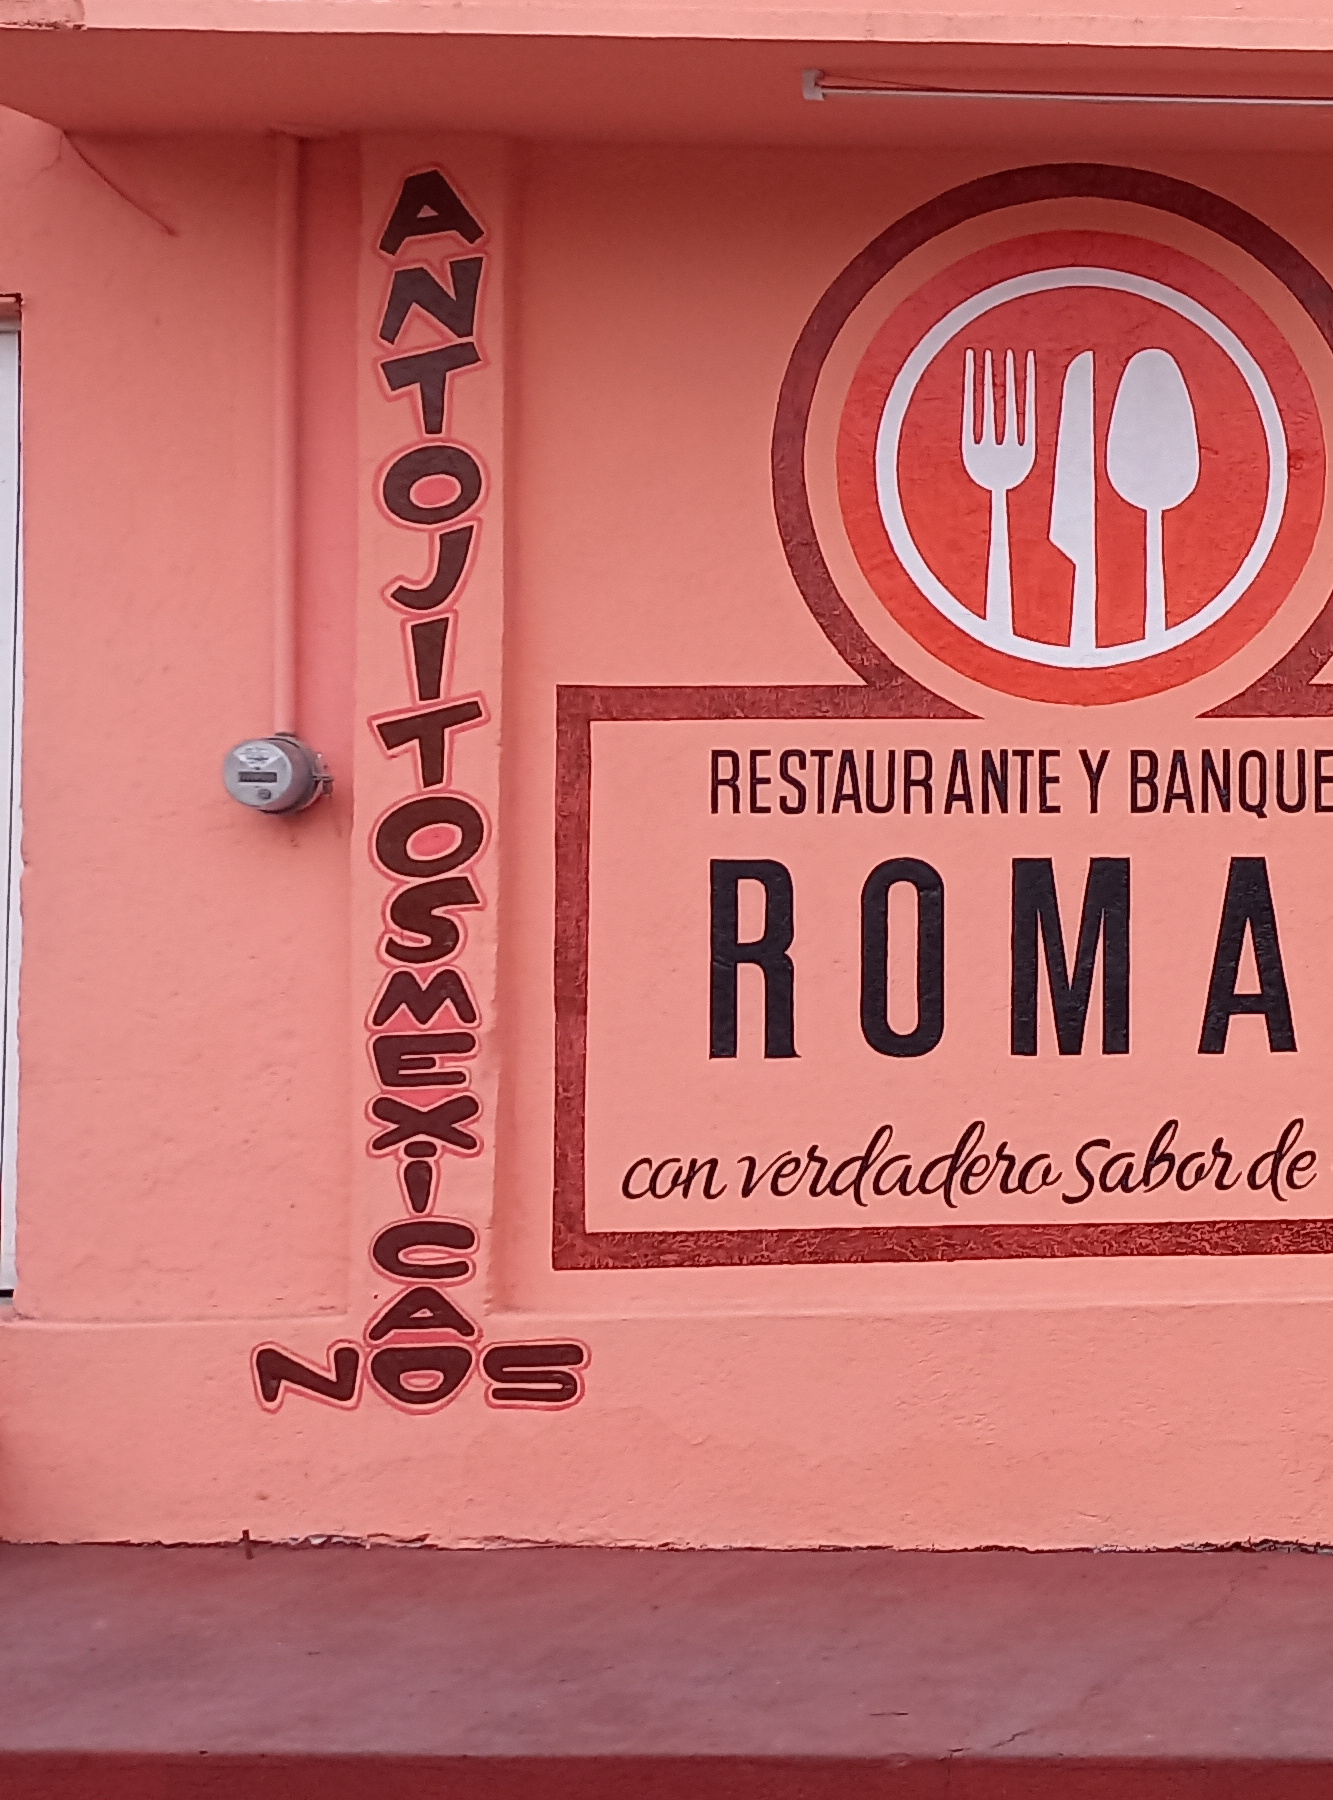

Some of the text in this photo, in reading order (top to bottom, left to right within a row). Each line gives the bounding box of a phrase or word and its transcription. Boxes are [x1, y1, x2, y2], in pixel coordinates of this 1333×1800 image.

[375, 167, 487, 964] ANTOJITOS
[709, 748, 1063, 816] RESTAURANTE
[1077, 748, 1114, 815] Y
[620, 1156, 728, 1201] con
[736, 1119, 1063, 1209] verdadero
[1245, 1116, 1318, 1203] de
